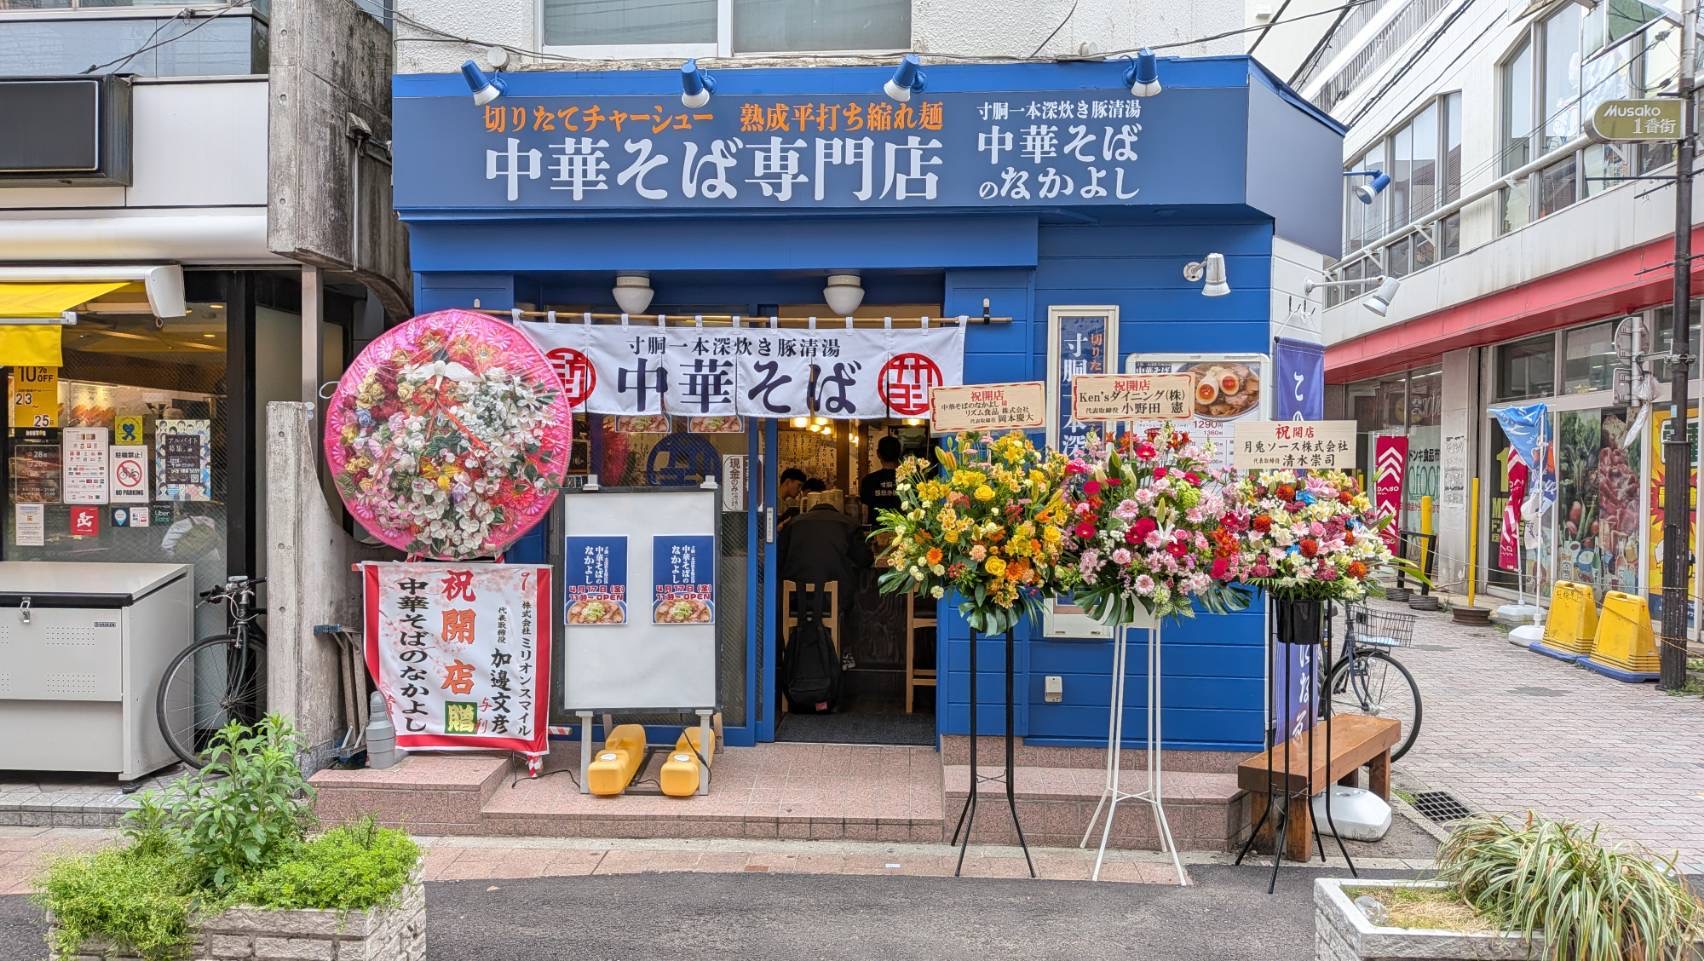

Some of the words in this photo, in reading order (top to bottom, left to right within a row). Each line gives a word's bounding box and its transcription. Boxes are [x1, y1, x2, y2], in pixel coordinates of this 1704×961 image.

[483, 103, 714, 133] 切りたてチャーシュー
[739, 101, 944, 132] 熟成平打ち縮れ麺
[976, 100, 1142, 120] 寸胴一本深炊き豚清湯
[1604, 104, 1662, 117] Musako
[1632, 118, 1676, 134] 1番街
[977, 123, 1142, 164] 中華そば
[485, 136, 944, 201] 中華そば専門店
[979, 166, 1140, 200] のなかよし
[628, 335, 842, 358] 寸胴一本深炊き豚清湯
[617, 357, 862, 415] 中華そば
[970, 390, 1005, 401] 祝開店
[1114, 380, 1151, 391] 祝開店
[941, 400, 999, 411] 中華そばのなかよし
[1002, 406, 1029, 414] 株式会社
[1121, 402, 1160, 414] 小野田
[1275, 424, 1315, 439] 祝開店
[584, 545, 594, 584] なかよし
[671, 545, 681, 584] なかよし
[441, 569, 476, 695] 祝開店
[397, 577, 430, 732] 中華そばのなかよし
